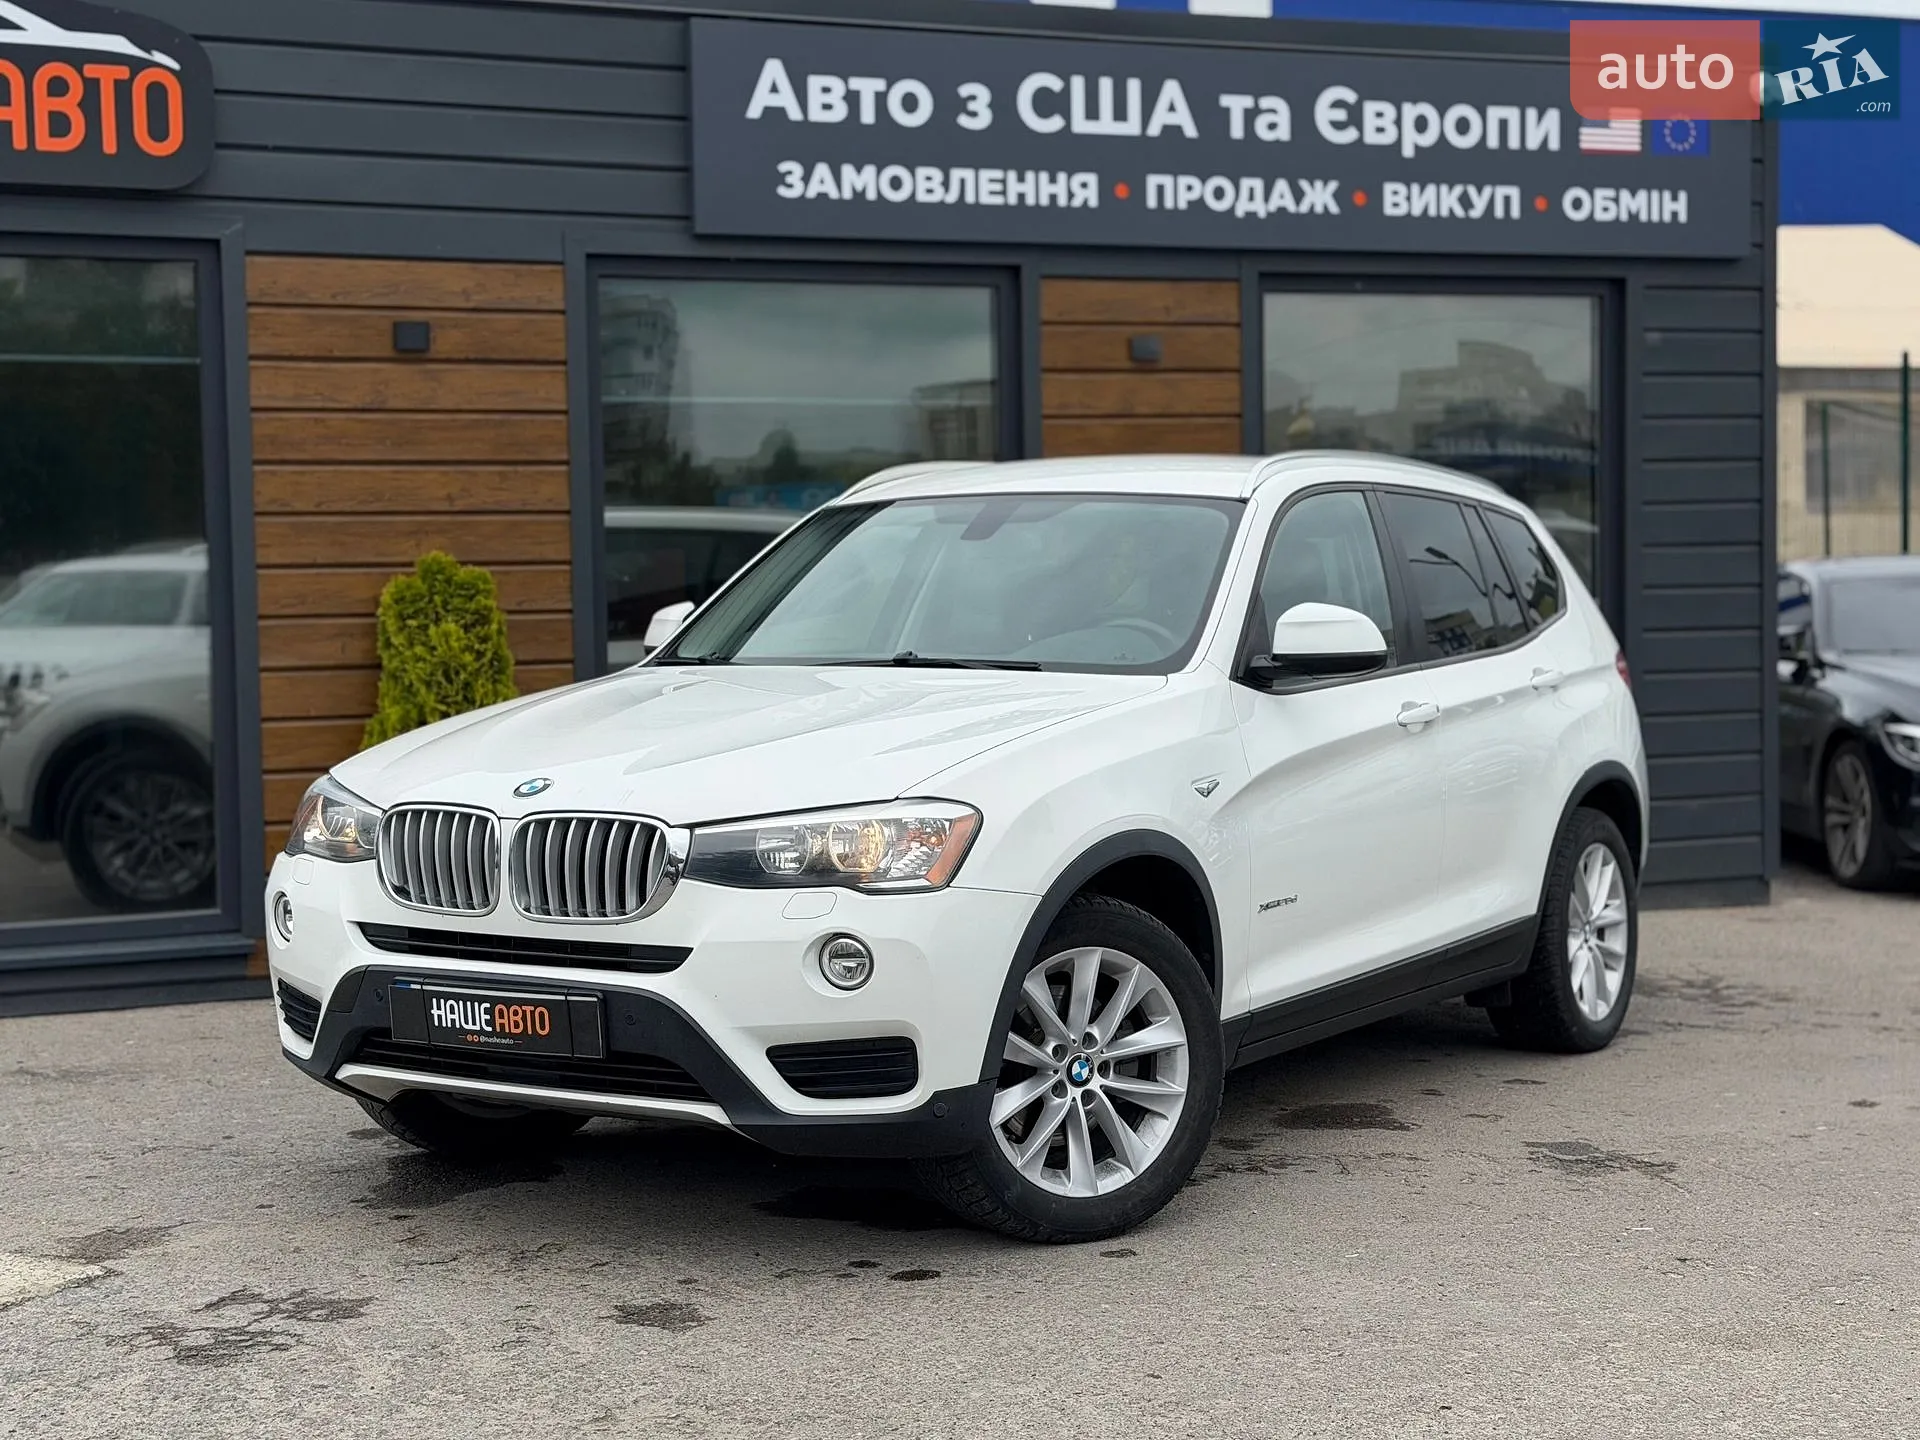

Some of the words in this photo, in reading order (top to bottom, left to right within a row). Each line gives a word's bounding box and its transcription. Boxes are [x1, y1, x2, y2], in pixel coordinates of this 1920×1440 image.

[746, 58, 934, 128] Авто
[956, 82, 993, 131] з
[1016, 72, 1199, 139] США
[1219, 94, 1291, 142] та
[1314, 85, 1561, 159] Європи
[776, 160, 1099, 208] ЗАМОВЛЕННЯ
[1145, 173, 1340, 219] ПРОДАЖ
[1382, 181, 1521, 220] ВИКУП
[1562, 186, 1688, 224] ОБМІН
[431, 997, 493, 1032] НАШЕ
[494, 1003, 550, 1036] АВТО
